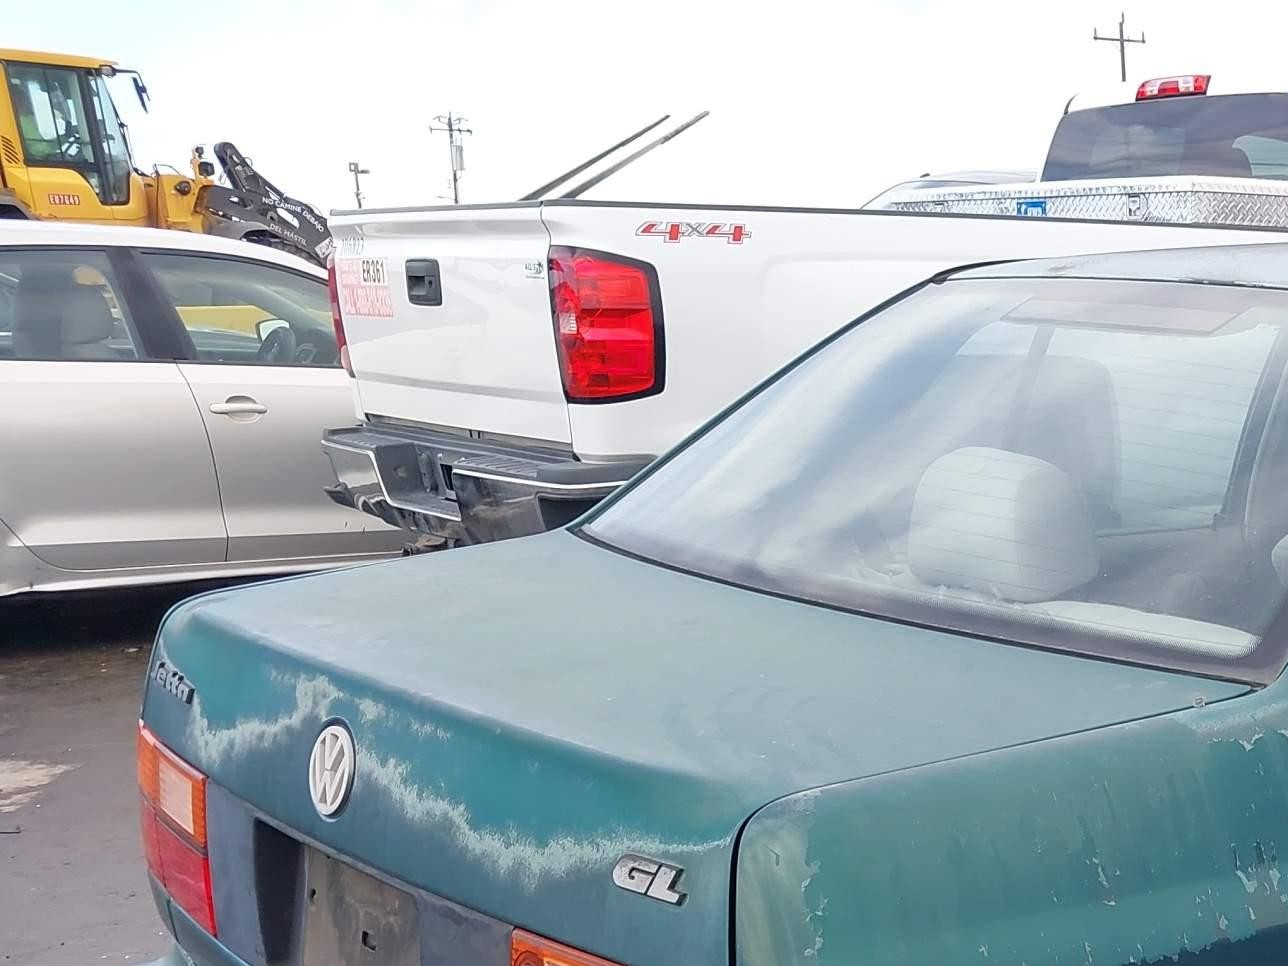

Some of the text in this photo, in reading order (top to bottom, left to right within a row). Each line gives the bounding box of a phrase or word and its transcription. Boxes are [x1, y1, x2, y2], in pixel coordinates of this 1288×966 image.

[262, 196, 325, 233] NO CAMINE DEBAJO
[269, 223, 283, 234] DEL
[361, 259, 385, 284] ER361
[151, 660, 193, 704] Jetta
[309, 725, 353, 816] VW
[612, 854, 686, 906] GL
